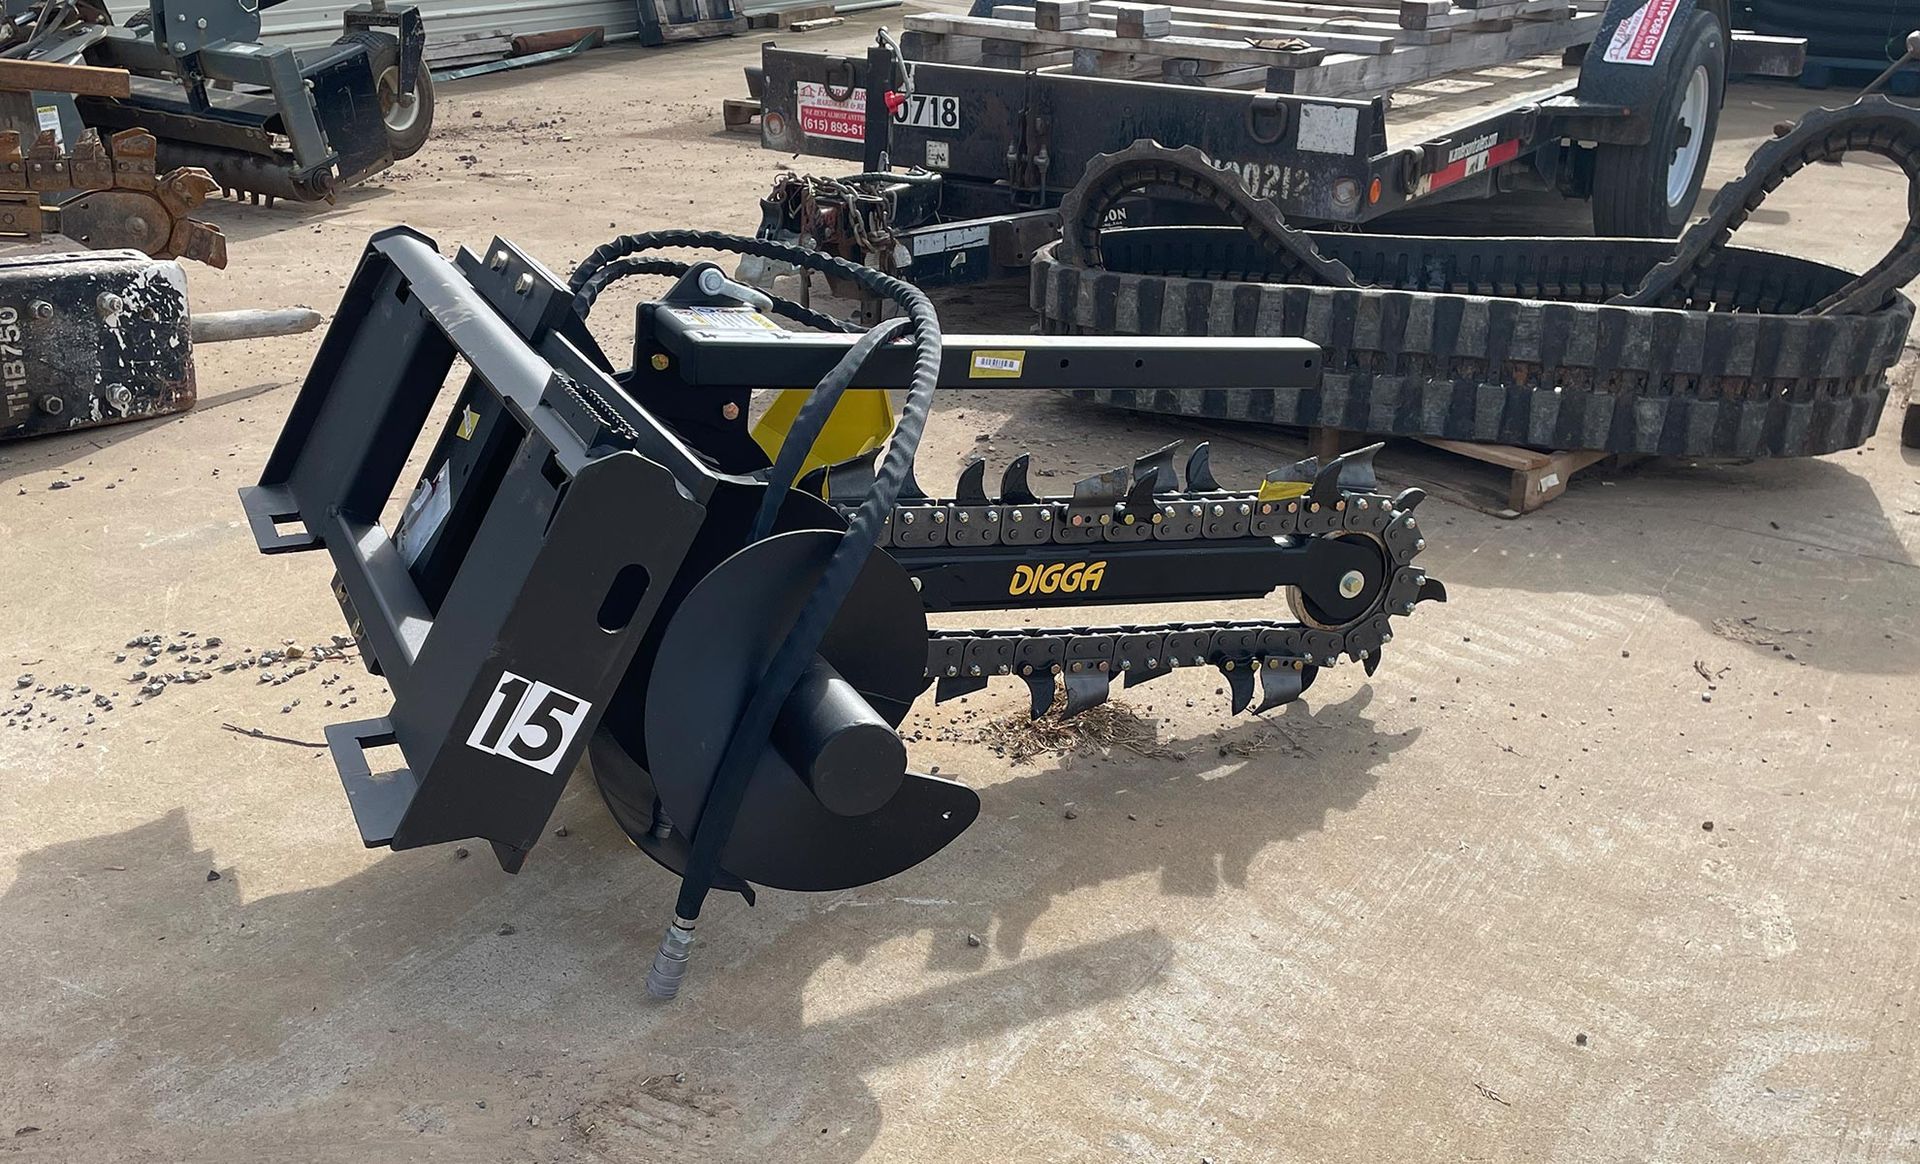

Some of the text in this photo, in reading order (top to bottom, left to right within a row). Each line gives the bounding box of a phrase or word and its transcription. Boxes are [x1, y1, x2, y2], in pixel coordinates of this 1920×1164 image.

[803, 117, 866, 135] (615) 893-61
[895, 96, 957, 127] 0718
[1104, 207, 1127, 222] ON
[0, 306, 30, 418] THB750
[1009, 561, 1107, 595] DIGGA
[480, 678, 579, 761] 15
